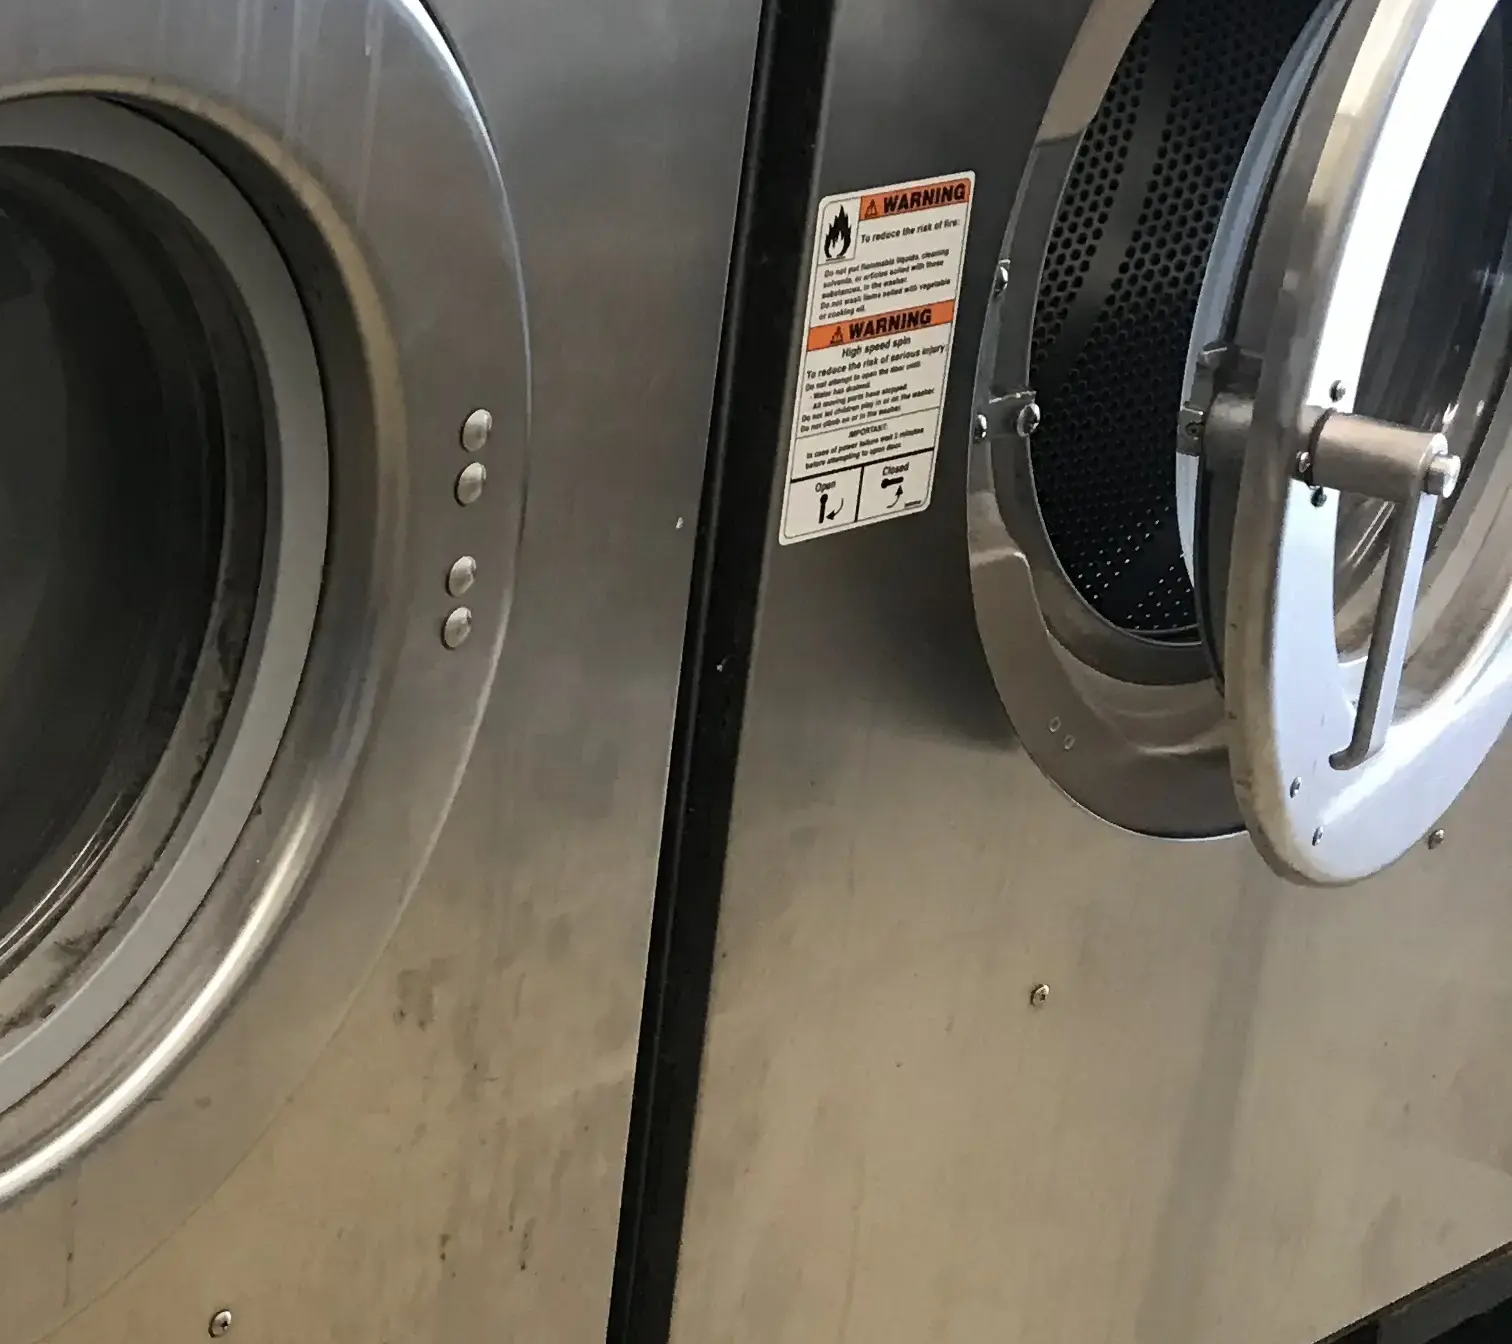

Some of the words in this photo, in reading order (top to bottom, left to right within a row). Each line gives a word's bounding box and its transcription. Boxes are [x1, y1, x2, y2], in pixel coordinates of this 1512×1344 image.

[883, 182, 965, 213] WARNING
[861, 233, 870, 243] To
[871, 229, 900, 241] reduce
[902, 226, 915, 236] the
[916, 222, 932, 233] risk
[933, 220, 943, 230] of
[848, 308, 931, 339] WARNING
[841, 345, 862, 358] High
[864, 338, 890, 354] speed
[892, 335, 911, 348] spin
[806, 370, 816, 379] To
[817, 365, 846, 377] reduce
[847, 361, 861, 371] the
[862, 356, 878, 367] risk
[879, 354, 889, 364] of
[890, 349, 920, 362] serious
[881, 461, 909, 476] Closed
[814, 480, 836, 493] Open
